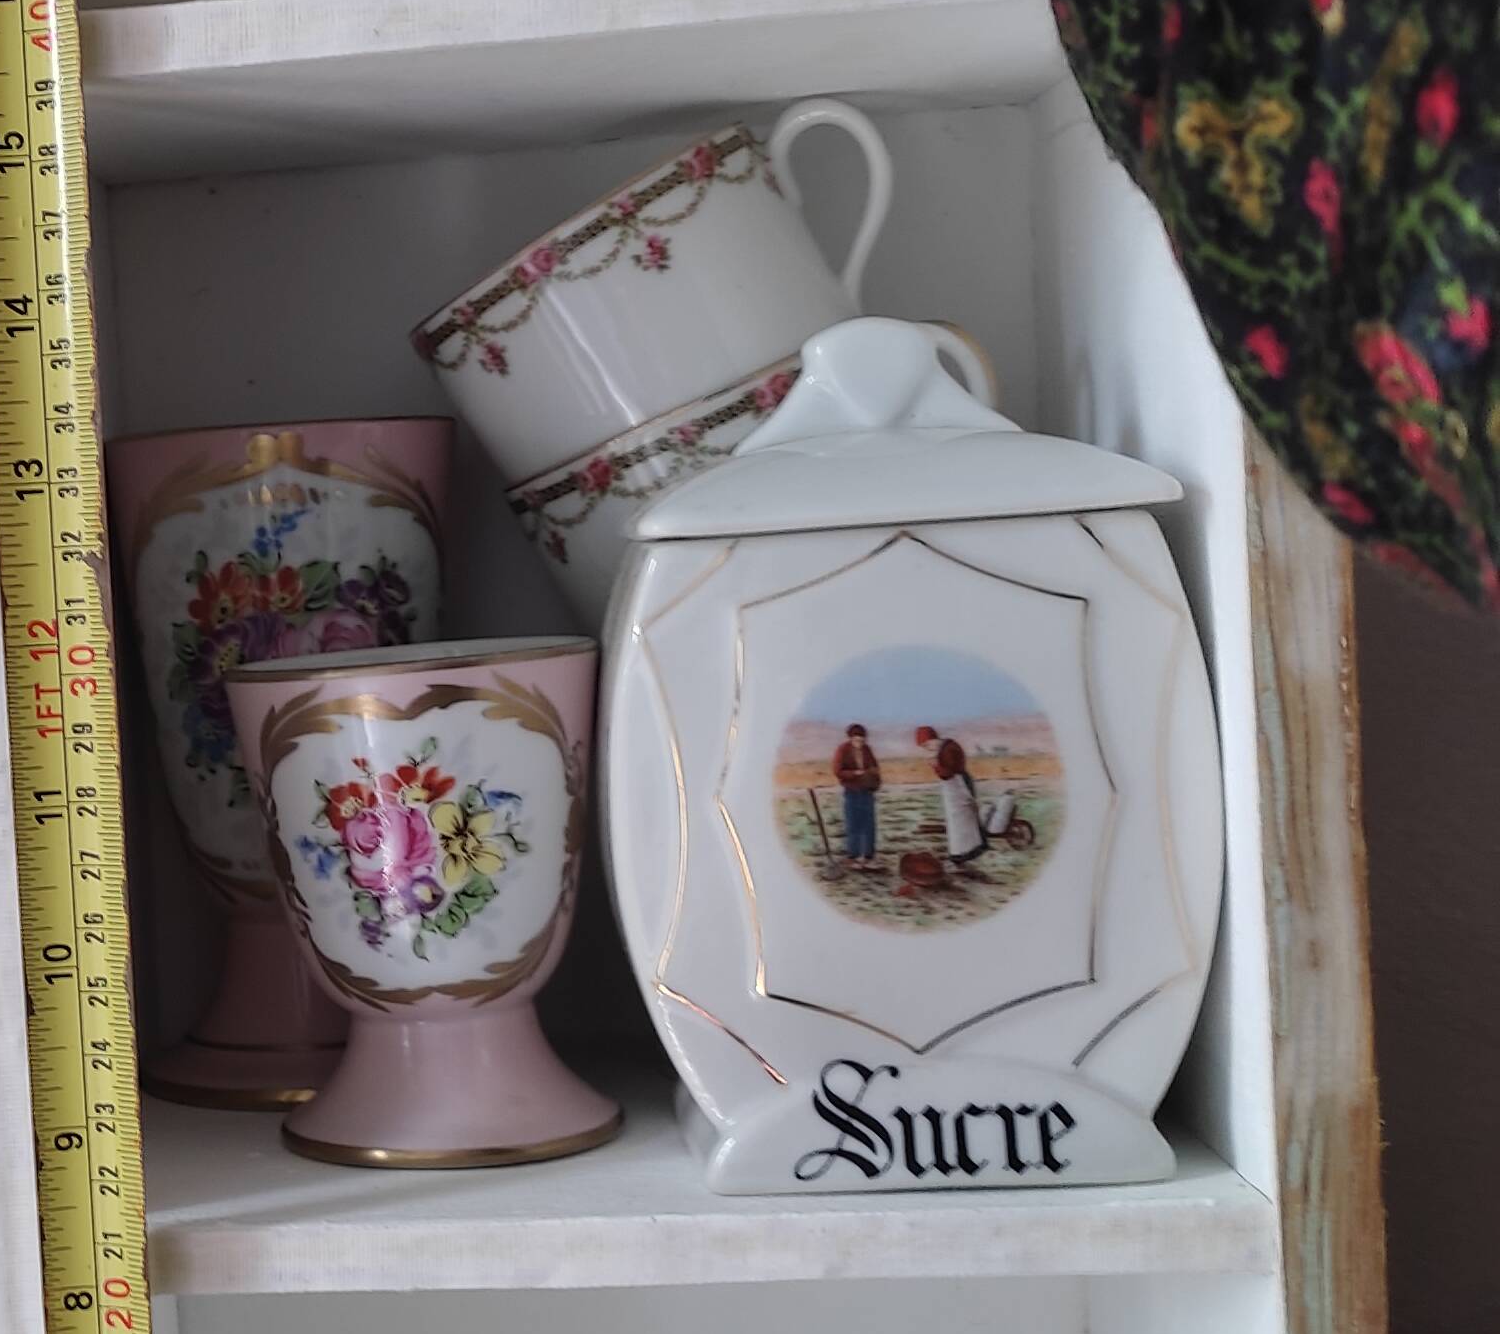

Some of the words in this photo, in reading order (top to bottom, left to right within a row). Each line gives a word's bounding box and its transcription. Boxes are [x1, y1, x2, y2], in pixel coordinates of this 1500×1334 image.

[36, 79, 56, 111] 39
[38, 144, 60, 176] 38
[42, 210, 64, 241] 37
[45, 274, 68, 306] 36
[4, 293, 36, 339] 14
[50, 337, 71, 371] 35
[53, 402, 75, 435] 34
[13, 459, 44, 502] 13
[57, 468, 78, 498] 33
[61, 531, 83, 563] 32
[65, 597, 85, 627] 31
[27, 619, 59, 661] 12
[68, 644, 98, 697] 30
[35, 683, 64, 739] 1FT
[72, 723, 94, 755] 29
[33, 790, 63, 826] 11
[76, 786, 98, 817] 28
[80, 850, 100, 881] 27
[83, 912, 105, 944] 26
[43, 944, 73, 985] 10
[87, 976, 108, 1007] 25
[91, 1039, 113, 1072] 24
[95, 1103, 116, 1134] 23
[793, 1058, 1077, 1181] Sucre
[54, 1132, 84, 1150] 9
[98, 1165, 120, 1197] 22
[102, 1231, 124, 1259] 21
[64, 1291, 93, 1312] 8
[104, 1278, 133, 1329] 20
